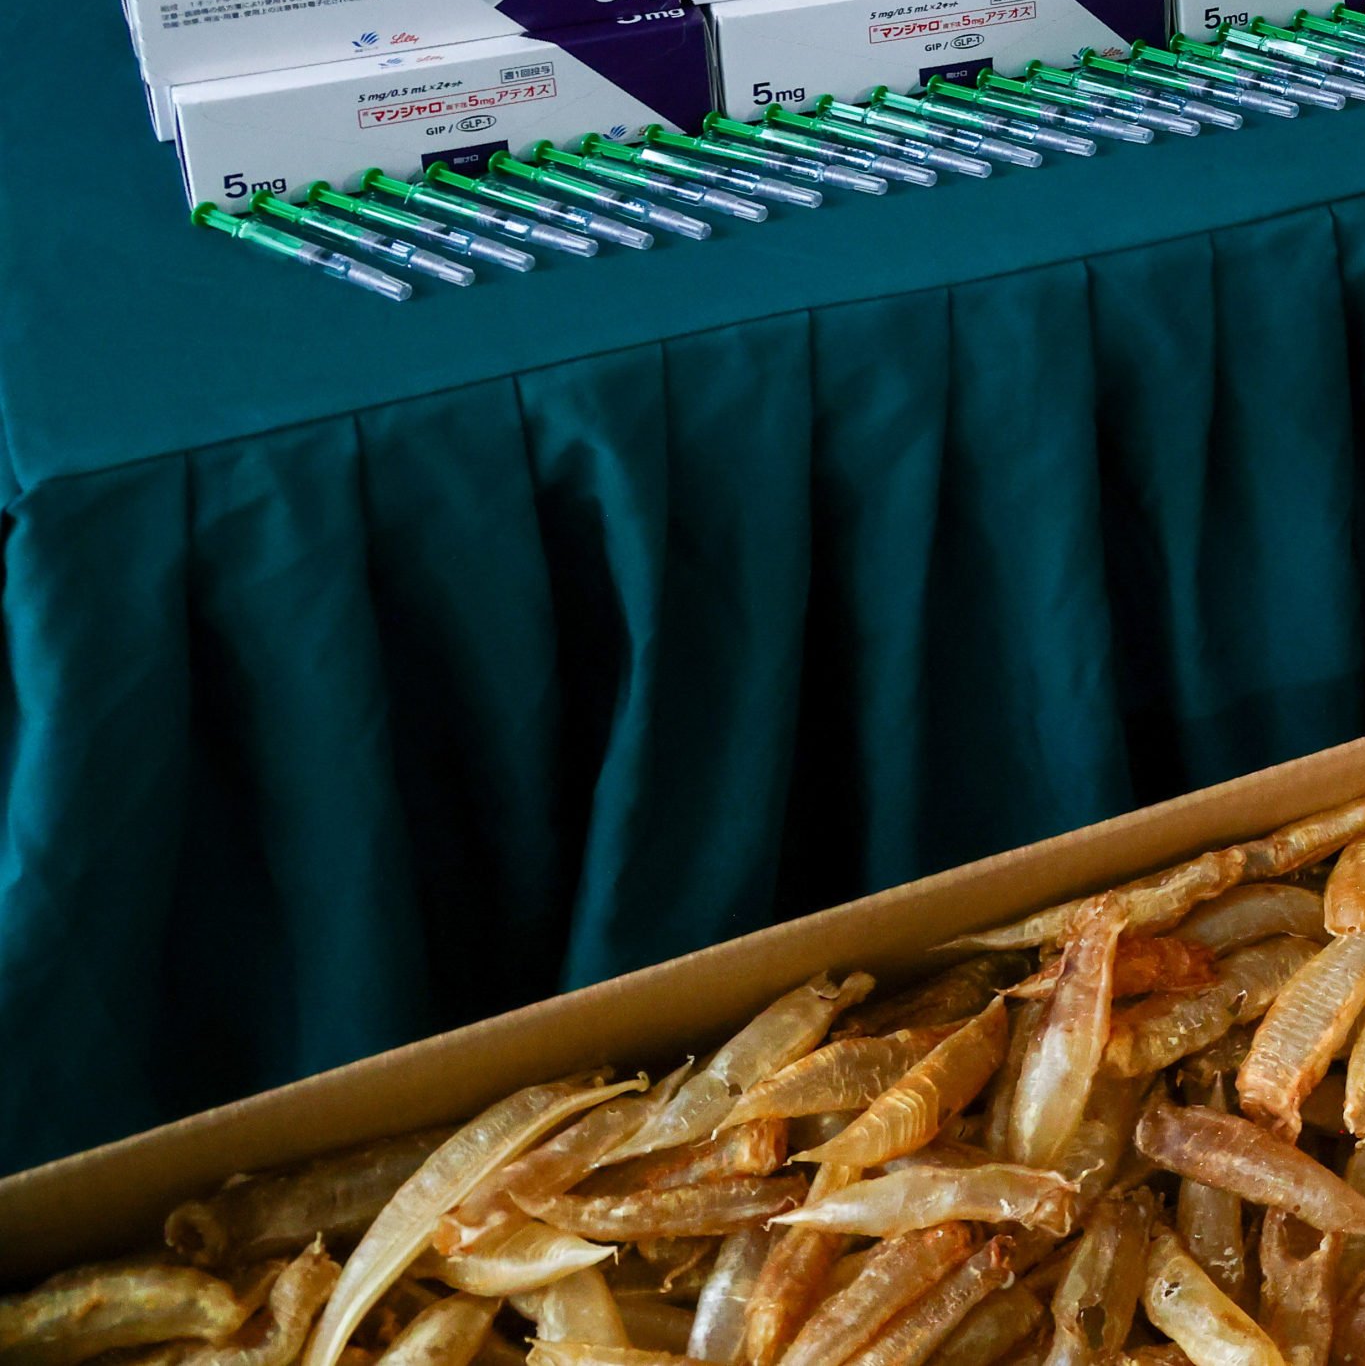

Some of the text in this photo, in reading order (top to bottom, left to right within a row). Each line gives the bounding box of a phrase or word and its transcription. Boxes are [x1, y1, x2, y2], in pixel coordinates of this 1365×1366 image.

[1204, 7, 1249, 30] 5mg
[925, 43, 942, 52] GIP
[752, 82, 806, 105] 5mg
[426, 126, 446, 136] GIP
[223, 173, 287, 199] 5mg
